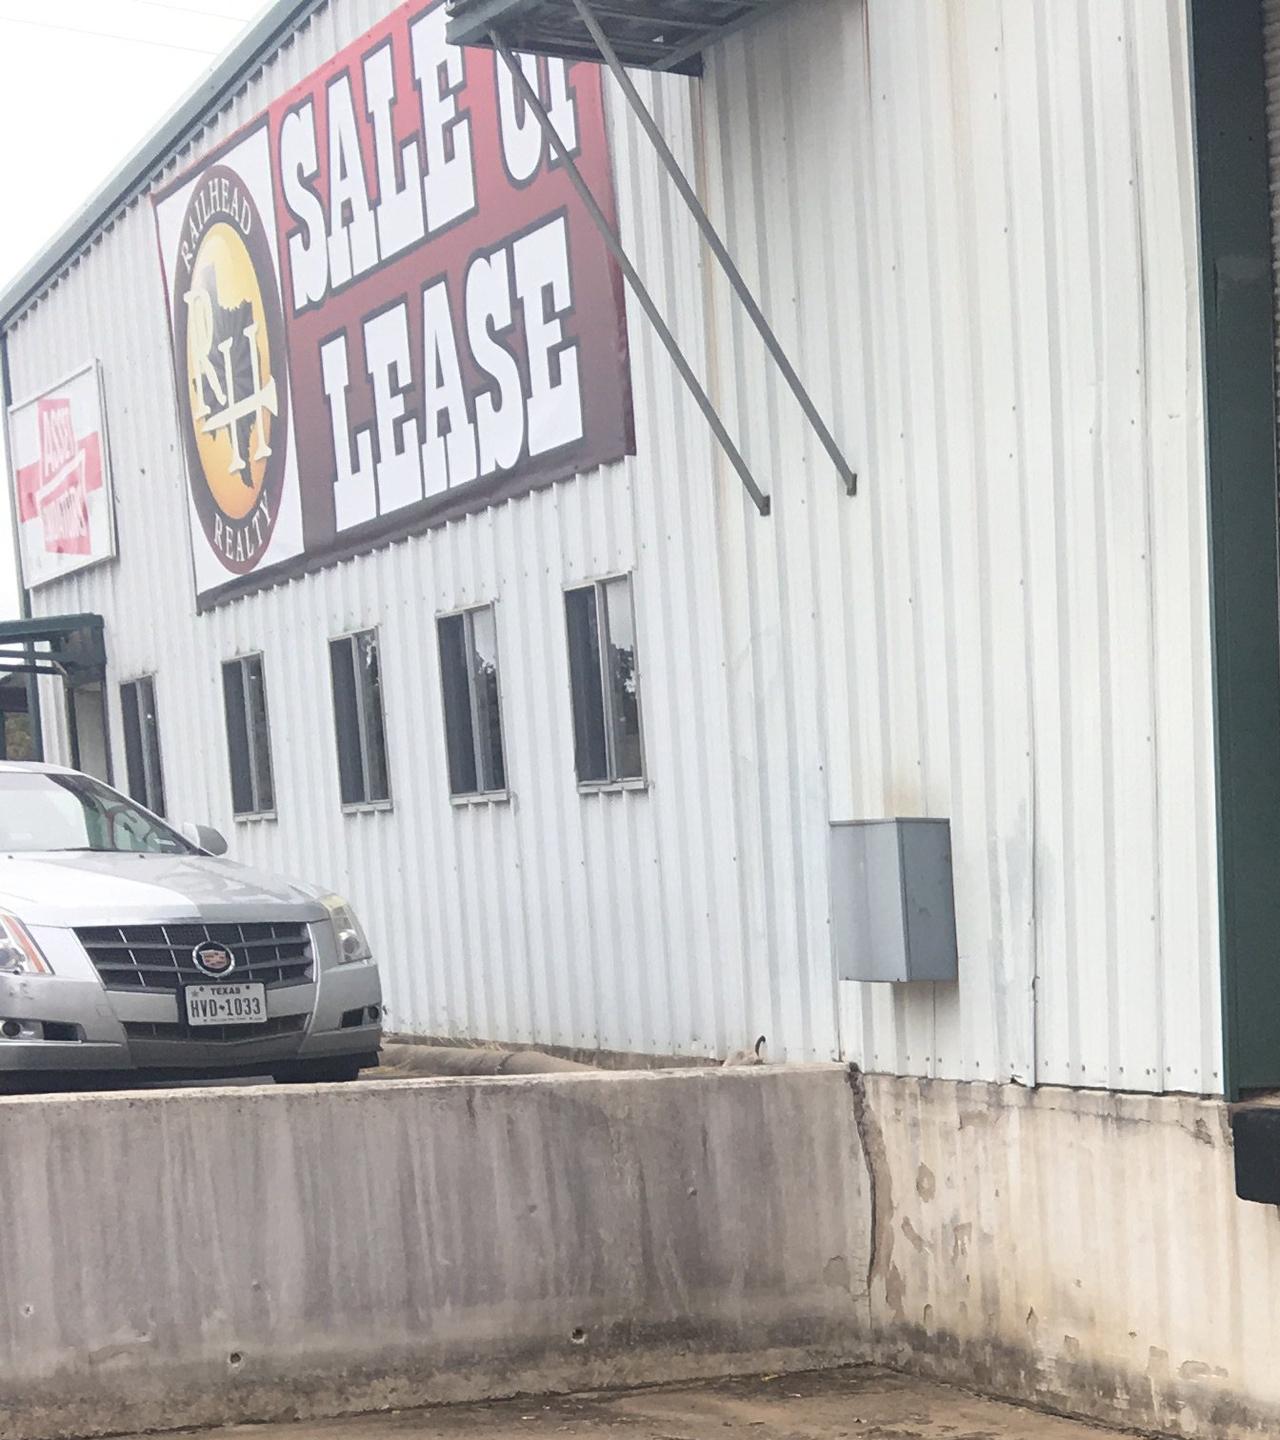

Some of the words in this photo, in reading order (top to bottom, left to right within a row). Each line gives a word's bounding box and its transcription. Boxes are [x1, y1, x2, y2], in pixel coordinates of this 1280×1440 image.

[280, 2, 476, 311] SALE
[181, 177, 252, 274] RAILHEAD
[321, 216, 583, 533] LEASE
[213, 491, 271, 562] REALTY
[211, 987, 241, 995] TEXAS
